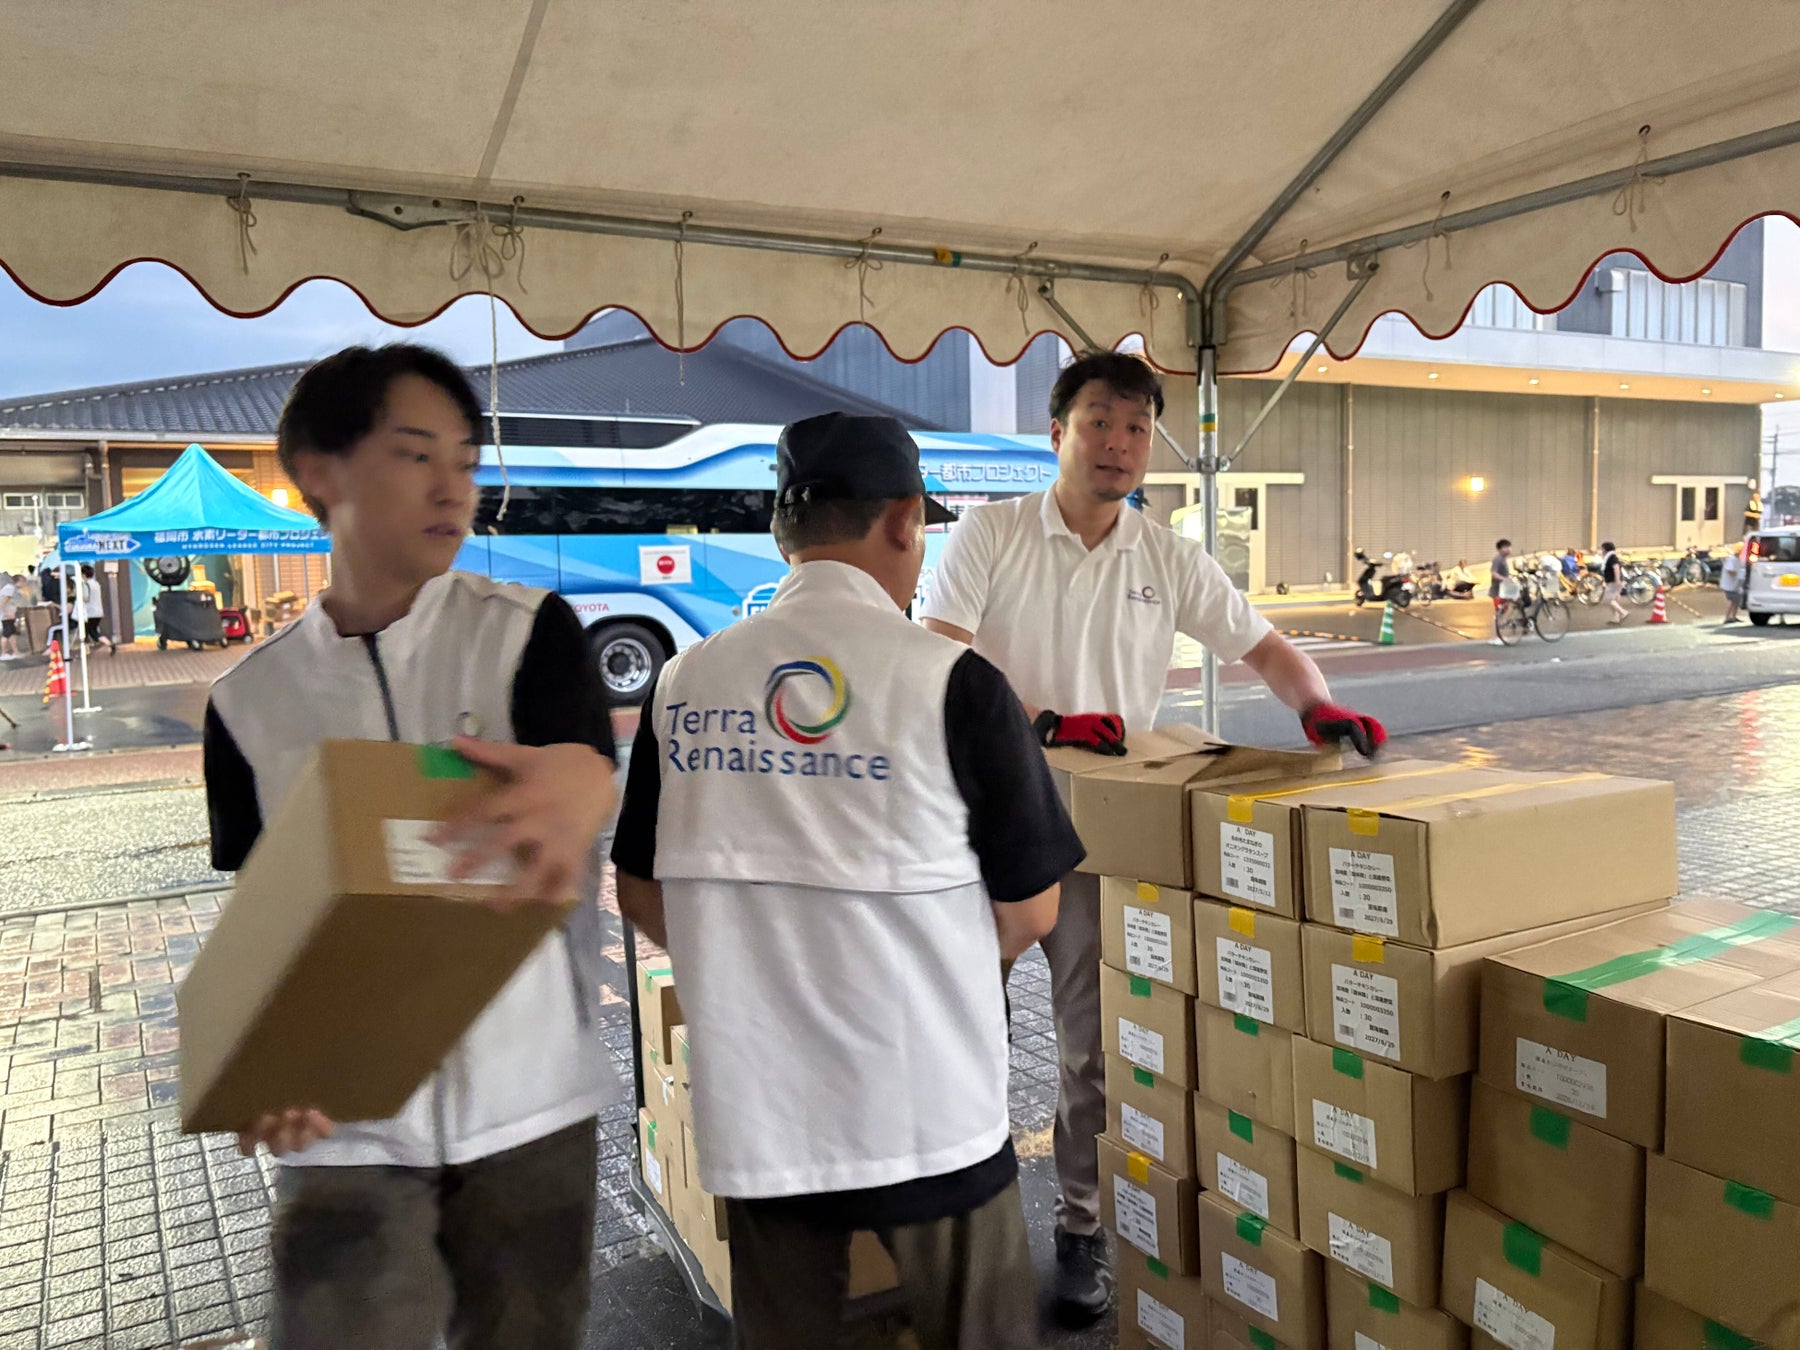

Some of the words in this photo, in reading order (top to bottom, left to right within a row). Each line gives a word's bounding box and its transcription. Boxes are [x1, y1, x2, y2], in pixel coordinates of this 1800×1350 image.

[98, 540, 124, 550] NEXT
[574, 603, 609, 612] OYOTA
[666, 702, 757, 735] Terra
[668, 738, 890, 780] Renaissance
[1244, 828, 1256, 837] DAY
[1240, 944, 1251, 952] DAY
[1360, 971, 1374, 980] DAY
[1557, 1050, 1576, 1062] DAY
